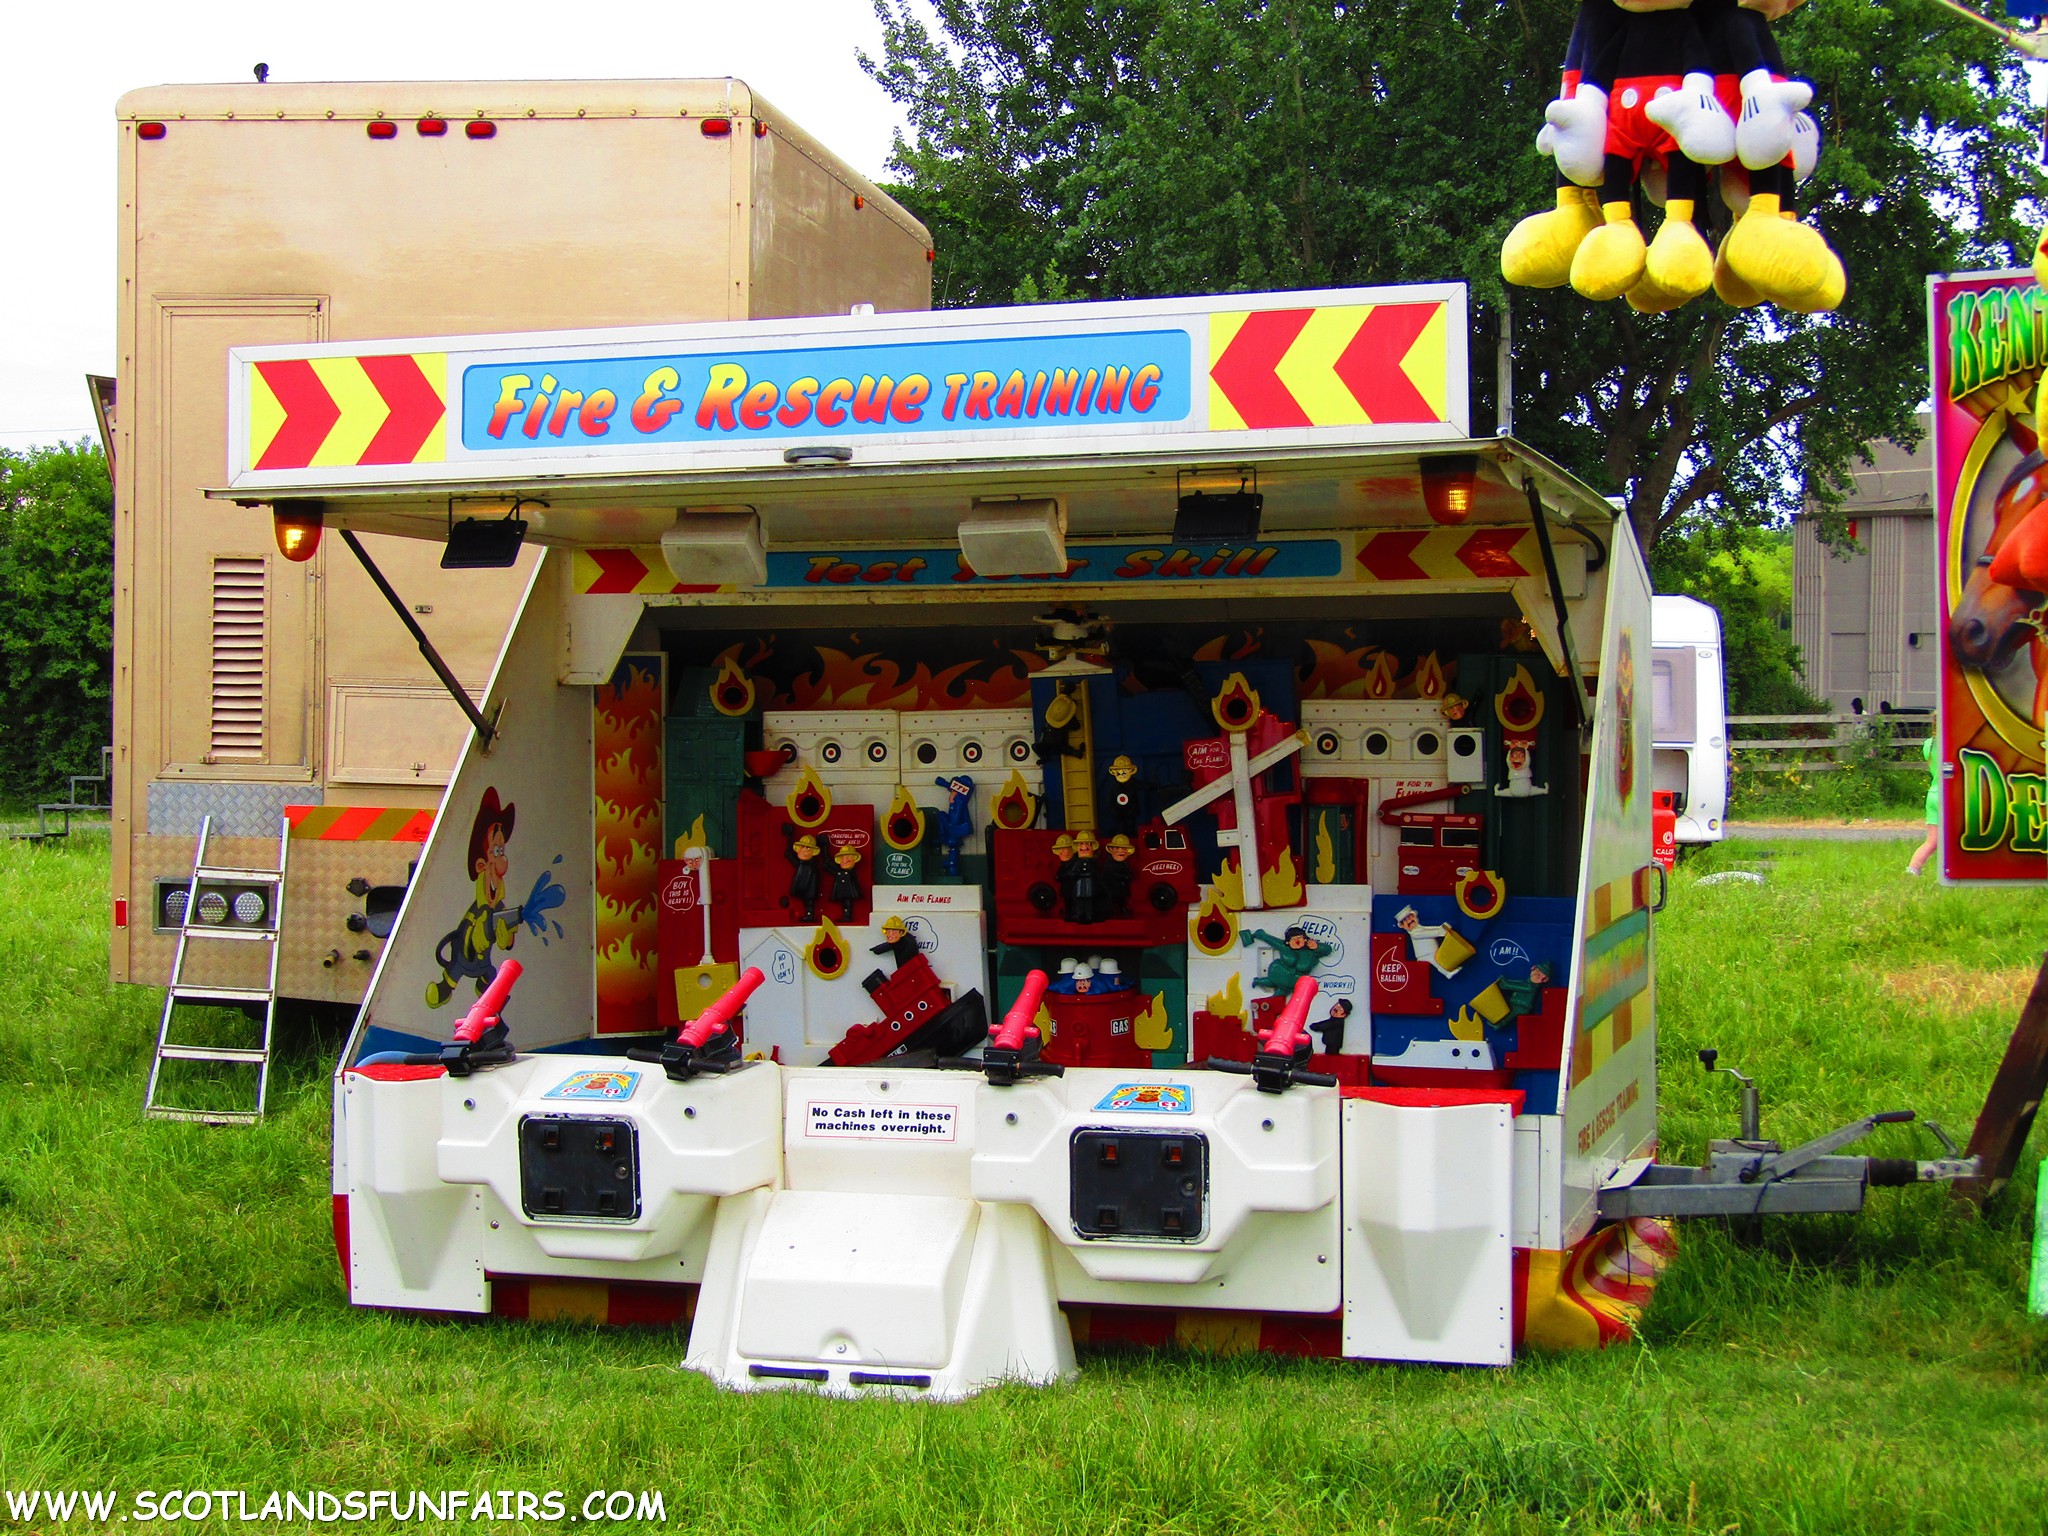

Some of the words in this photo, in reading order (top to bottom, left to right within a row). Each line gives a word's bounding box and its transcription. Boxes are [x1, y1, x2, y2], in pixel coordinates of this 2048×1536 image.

[487, 373, 617, 439] Fire
[630, 365, 683, 435] &
[694, 361, 930, 432] Rescue
[942, 363, 1163, 422] TRAINING
[803, 555, 927, 584] Test
[1114, 546, 1279, 579] Skill
[1192, 746, 1207, 756] AIM
[1205, 756, 1224, 764] FLAME
[890, 867, 911, 875] FLAME
[672, 881, 688, 889] BOY
[896, 894, 909, 903] AIM
[911, 894, 925, 903] FOR
[926, 894, 952, 904] FLAMES
[1301, 921, 1334, 938] HELP!
[1499, 946, 1519, 956] AM!!
[778, 953, 786, 961] NO
[1381, 963, 1402, 973] KEEP
[1380, 974, 1406, 983] BALEING
[1112, 1018, 1129, 1034] GAS
[812, 1107, 829, 1117] No
[834, 1108, 866, 1118] Cash
[870, 1109, 894, 1119] left
[898, 1110, 910, 1120] in
[915, 1111, 951, 1121] these
[815, 1121, 876, 1131] machines
[881, 1123, 946, 1135] overnight.
